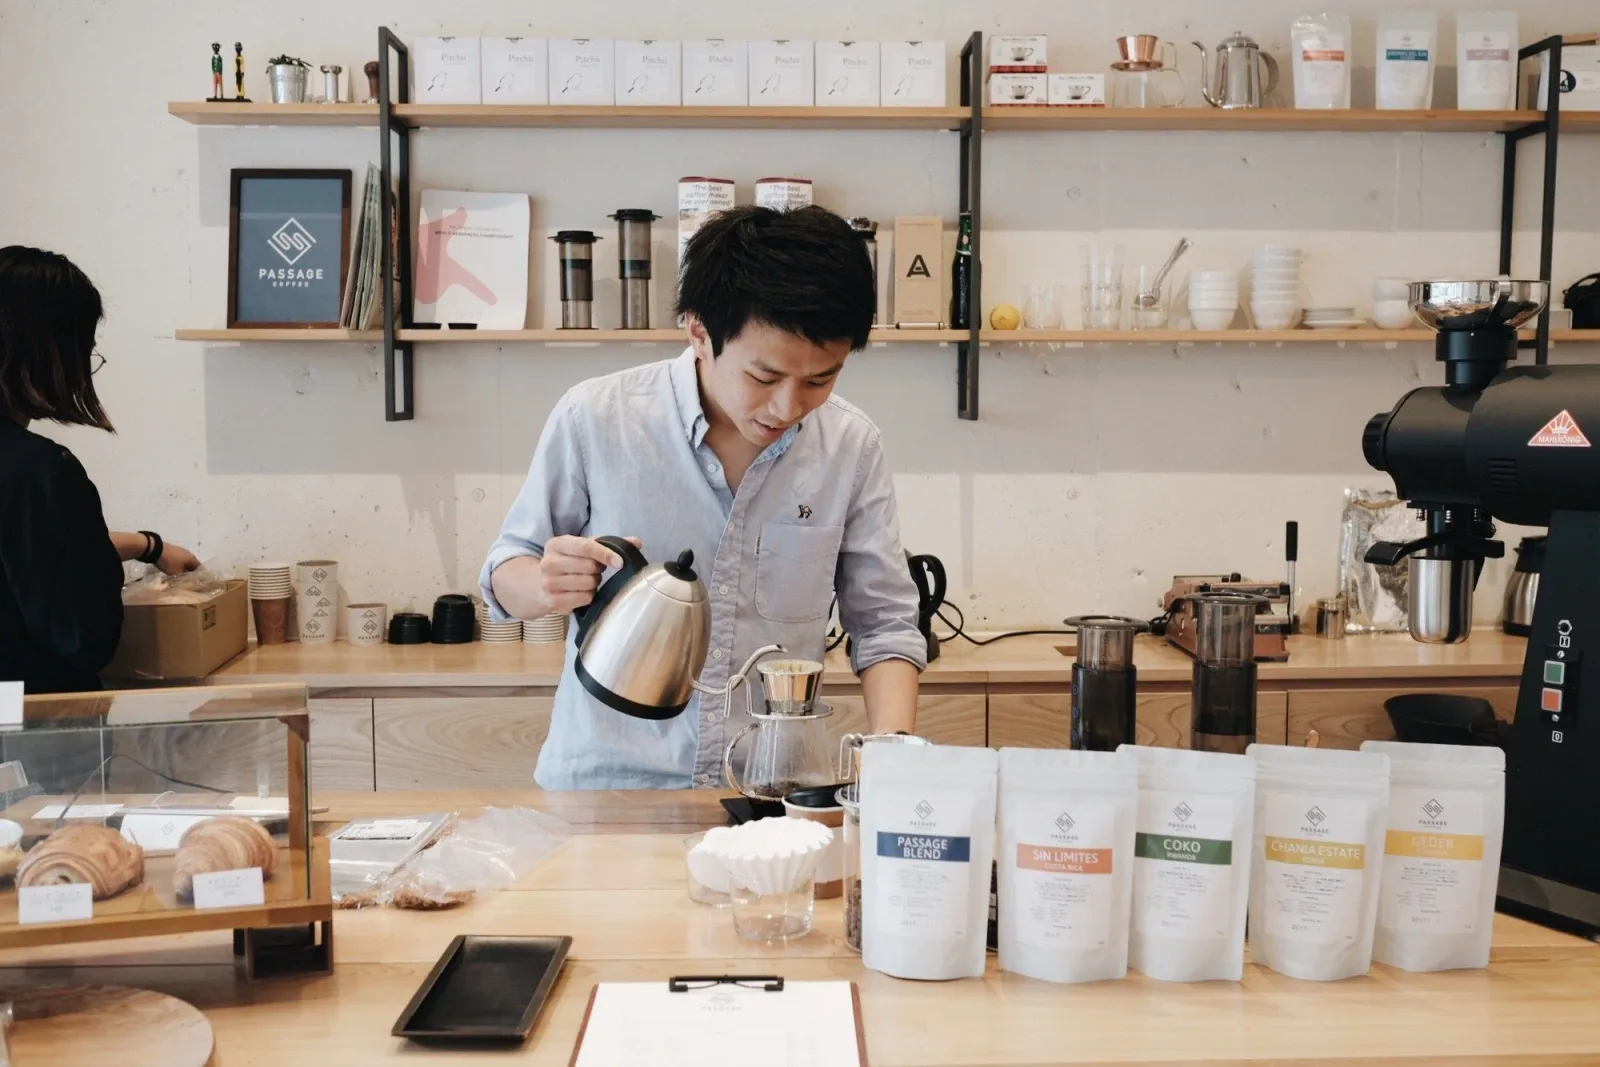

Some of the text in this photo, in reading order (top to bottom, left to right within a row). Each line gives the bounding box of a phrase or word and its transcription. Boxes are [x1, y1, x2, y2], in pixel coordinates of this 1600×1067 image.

[258, 268, 324, 280] PASSAGE
[897, 836, 948, 850] PASSAGE
[1163, 839, 1201, 853] COKO
[903, 847, 941, 860] BLEND
[1033, 849, 1098, 864] SIN LIMITES
[1166, 852, 1197, 861] RWANDA
[1271, 841, 1361, 859] CHANIA ESTATE
[1044, 862, 1084, 872] COSTA RICA
